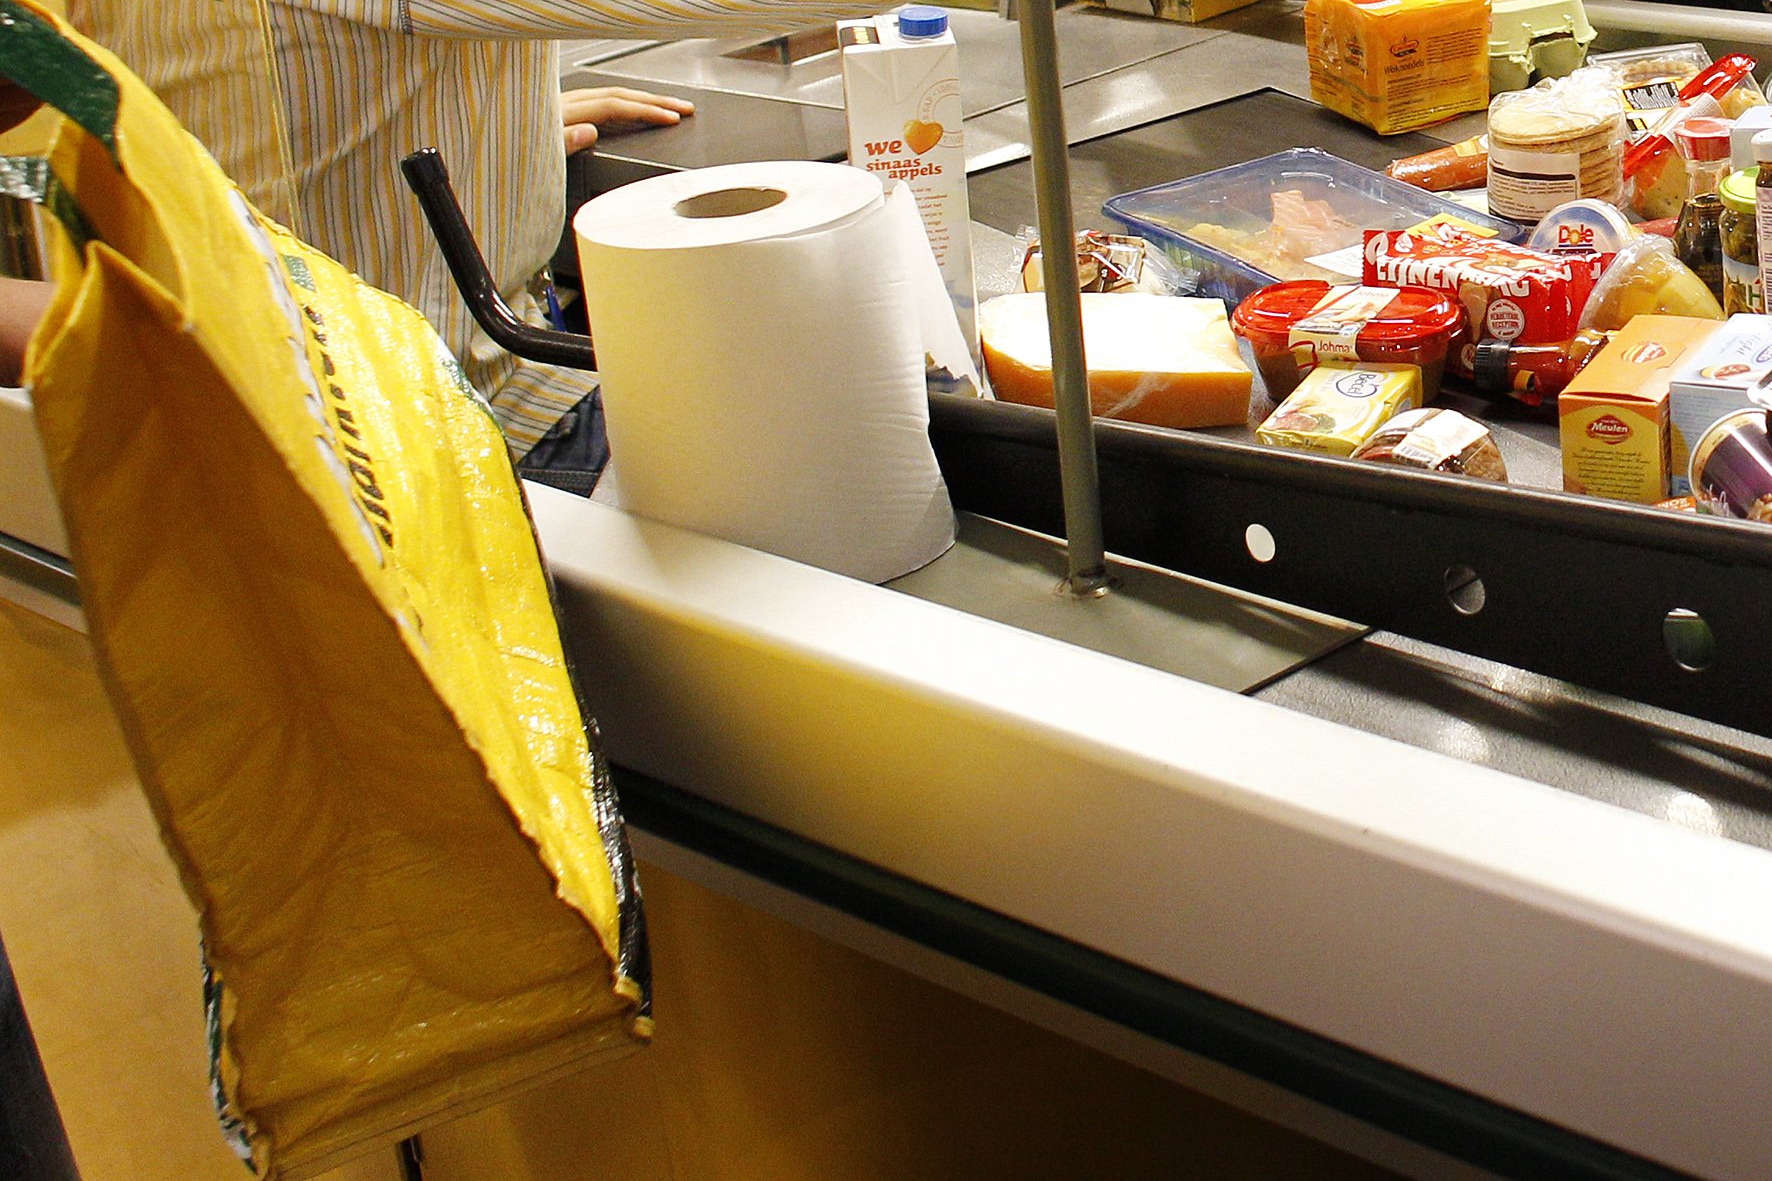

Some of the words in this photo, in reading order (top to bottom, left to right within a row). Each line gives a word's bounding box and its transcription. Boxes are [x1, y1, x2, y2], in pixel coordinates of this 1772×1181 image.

[864, 139, 903, 157] we
[866, 158, 921, 172] sinaas
[888, 162, 943, 181] appels
[1558, 223, 1594, 245] Dole
[1318, 340, 1350, 353] Johma
[1349, 372, 1377, 395] Becel
[1590, 422, 1629, 433] Meulen
